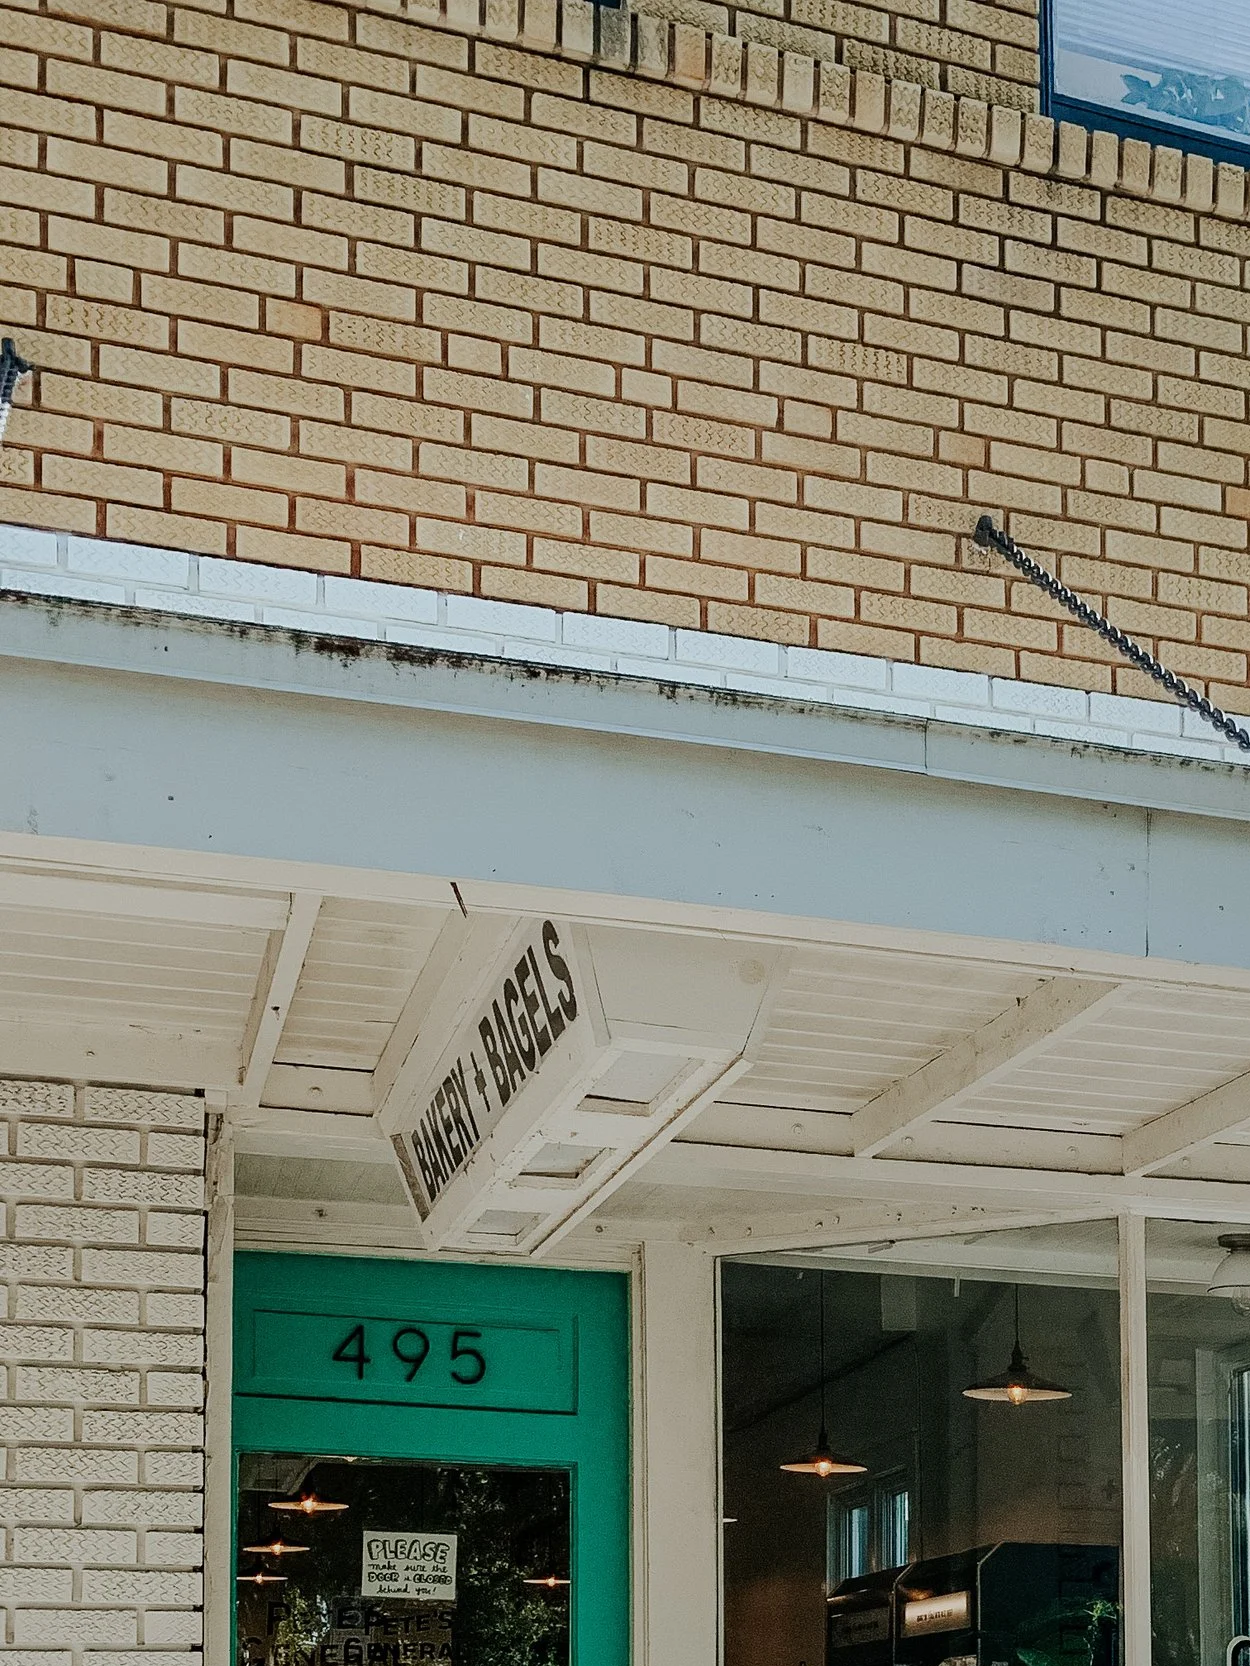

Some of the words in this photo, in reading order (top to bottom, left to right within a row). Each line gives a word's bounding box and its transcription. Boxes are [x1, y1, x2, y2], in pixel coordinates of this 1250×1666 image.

[411, 1056, 480, 1203] BAKERY
[478, 920, 577, 1107] BAGELS
[332, 1323, 486, 1384] 495
[367, 1539, 450, 1564] PLEASE
[368, 1561, 396, 1571] make
[404, 1564, 427, 1572] sure
[431, 1564, 448, 1573] the
[368, 1572, 400, 1582] DOOR
[413, 1573, 452, 1585] CLOSED
[377, 1584, 410, 1594] behind
